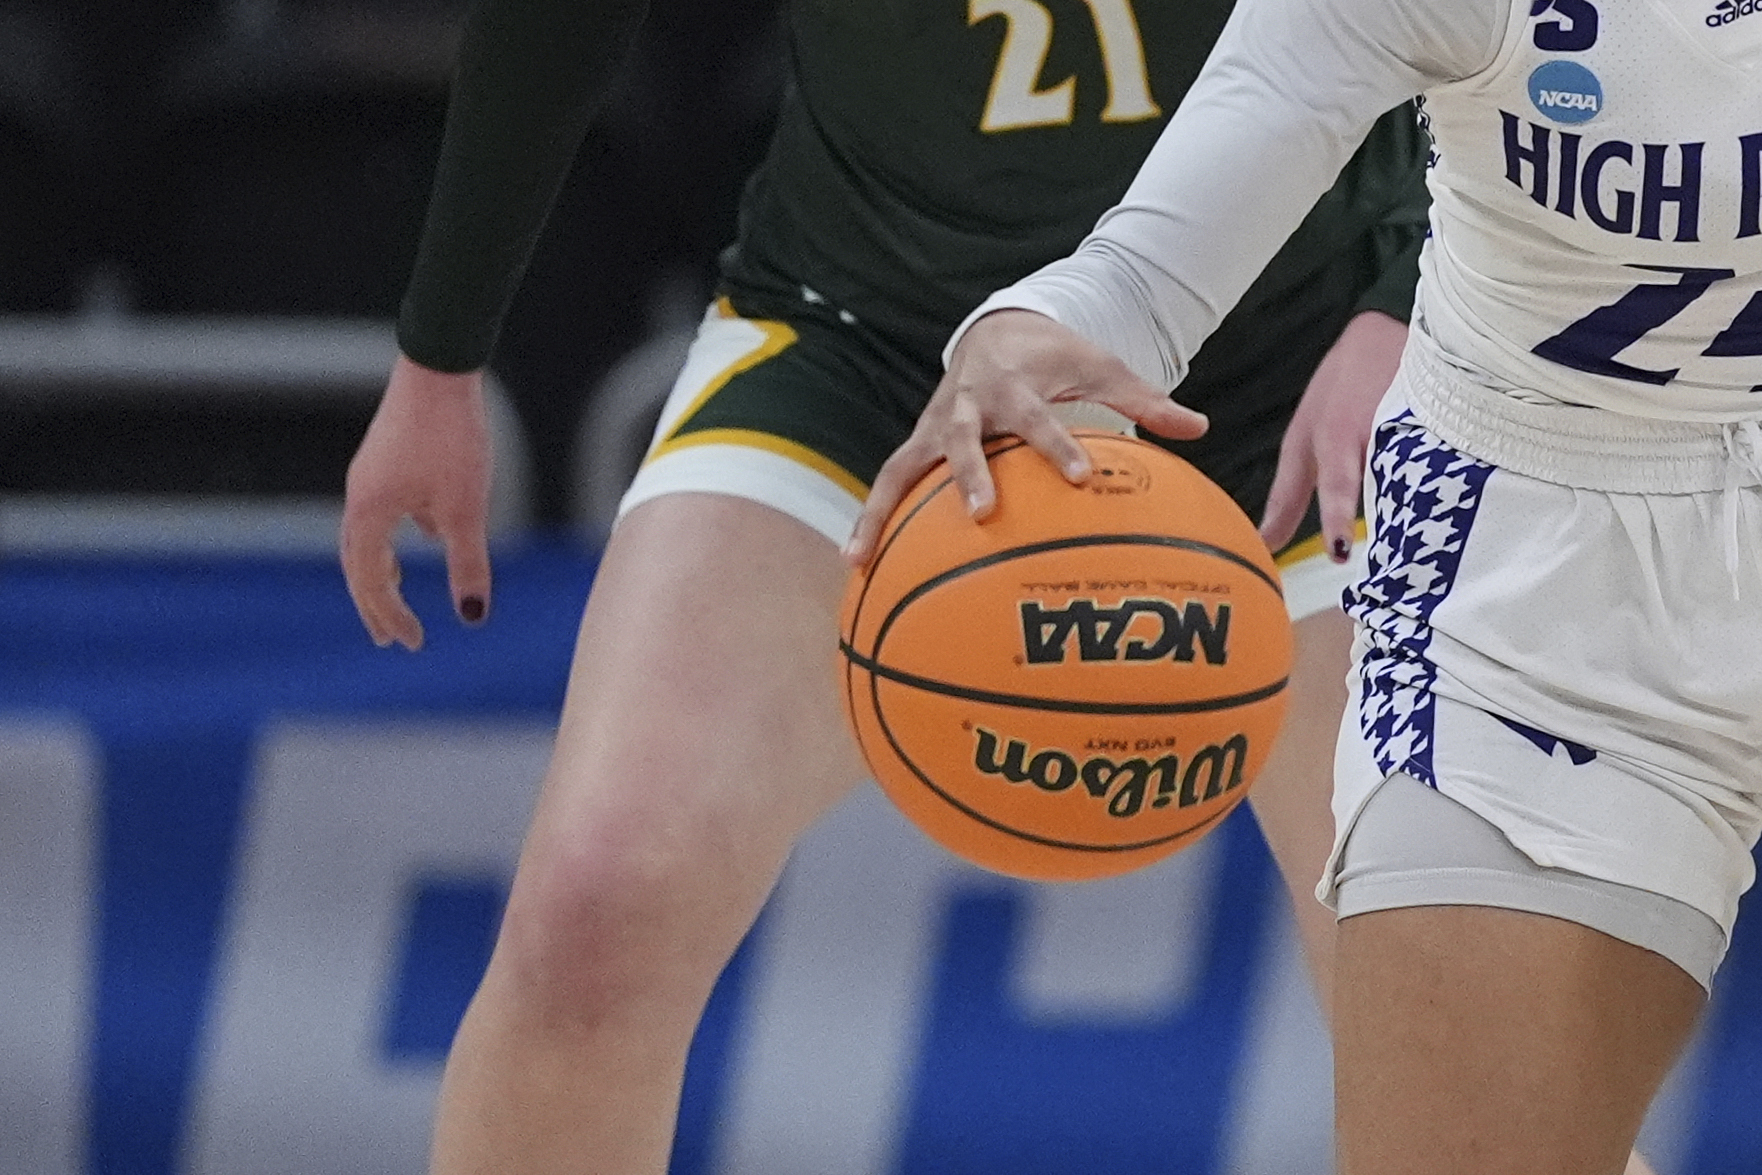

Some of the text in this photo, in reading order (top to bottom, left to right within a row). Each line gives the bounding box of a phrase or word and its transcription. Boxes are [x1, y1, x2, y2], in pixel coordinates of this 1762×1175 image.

[1538, 89, 1598, 112] NCAA
[1499, 109, 1706, 242] HIGH
[1020, 599, 1232, 666] NCAA
[974, 726, 1248, 818] Wilson
